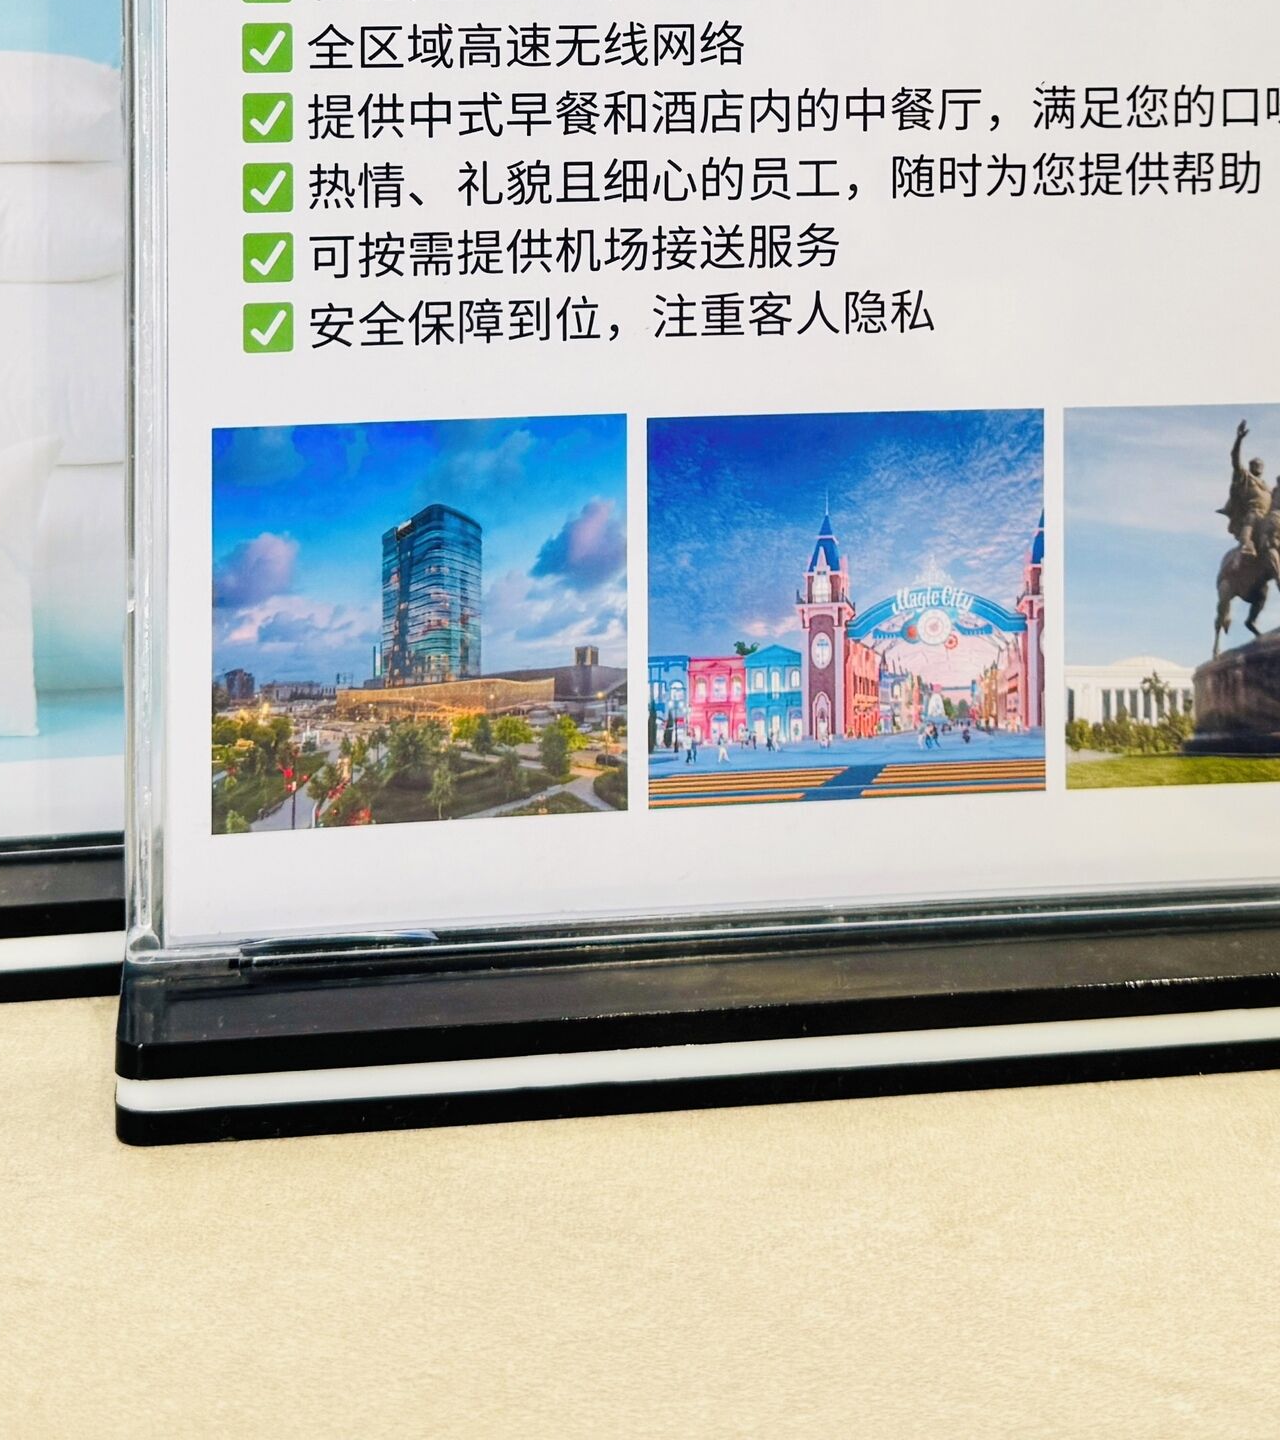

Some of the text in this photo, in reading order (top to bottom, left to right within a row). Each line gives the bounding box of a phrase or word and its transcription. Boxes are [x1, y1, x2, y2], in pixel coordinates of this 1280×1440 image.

[308, 20, 744, 69] 全区域高速无线网络
[309, 150, 1260, 209] 热情、礼貌且细心的员工，随时为您提供帮助
[309, 224, 839, 278] 可按需提供机场接送服务
[310, 289, 934, 349] 安全保障到位，注重客人隐私
[892, 585, 975, 615] Magic City
